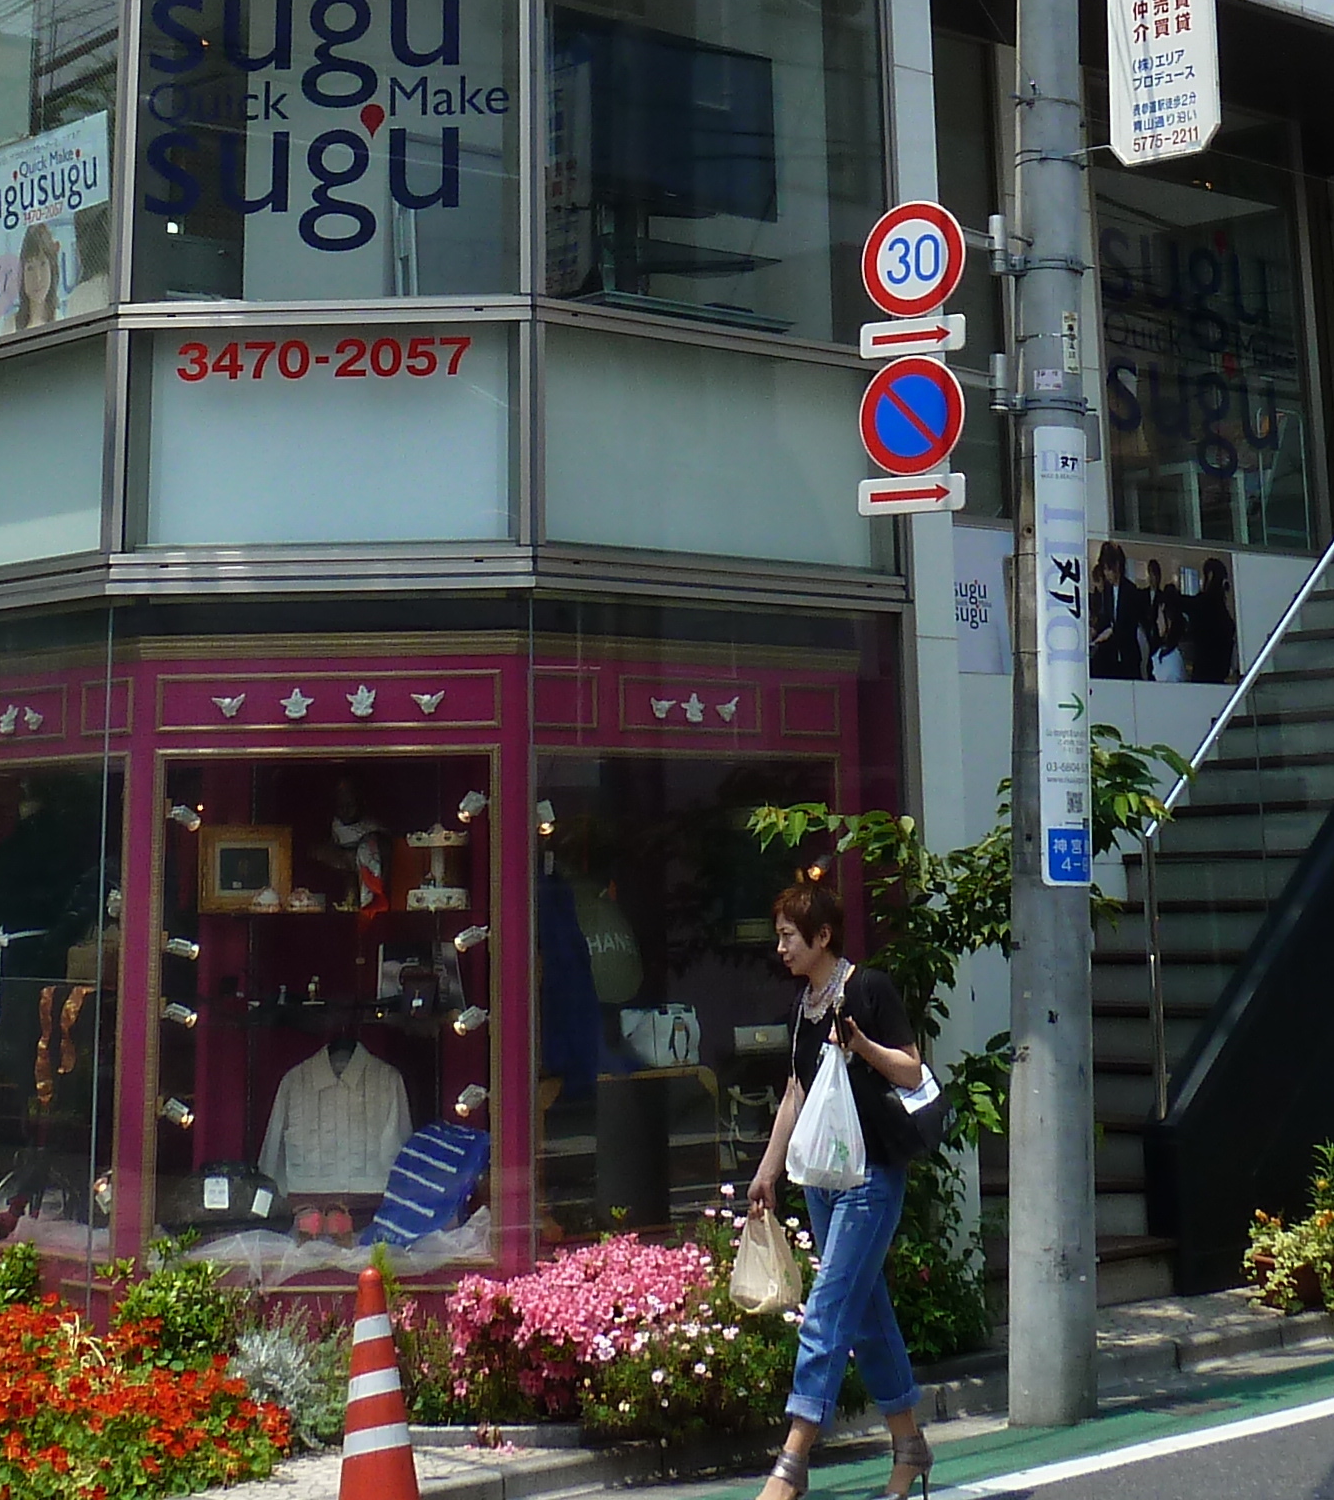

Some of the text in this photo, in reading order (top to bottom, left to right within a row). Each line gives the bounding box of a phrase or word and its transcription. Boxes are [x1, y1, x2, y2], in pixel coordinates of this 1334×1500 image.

[1132, 1, 1150, 43] 仲介
[1133, 65, 1196, 92] プロデュース
[148, 76, 510, 126] Quick Make
[1133, 110, 1197, 133] 青山通り沿い
[1133, 126, 1199, 153] 5775-2211
[19, 154, 48, 178] Quick
[49, 147, 74, 168] Make
[144, 126, 459, 252] sugu
[886, 233, 941, 285] 30
[176, 336, 471, 382] 3470-2057
[1106, 356, 1279, 481] sugu
